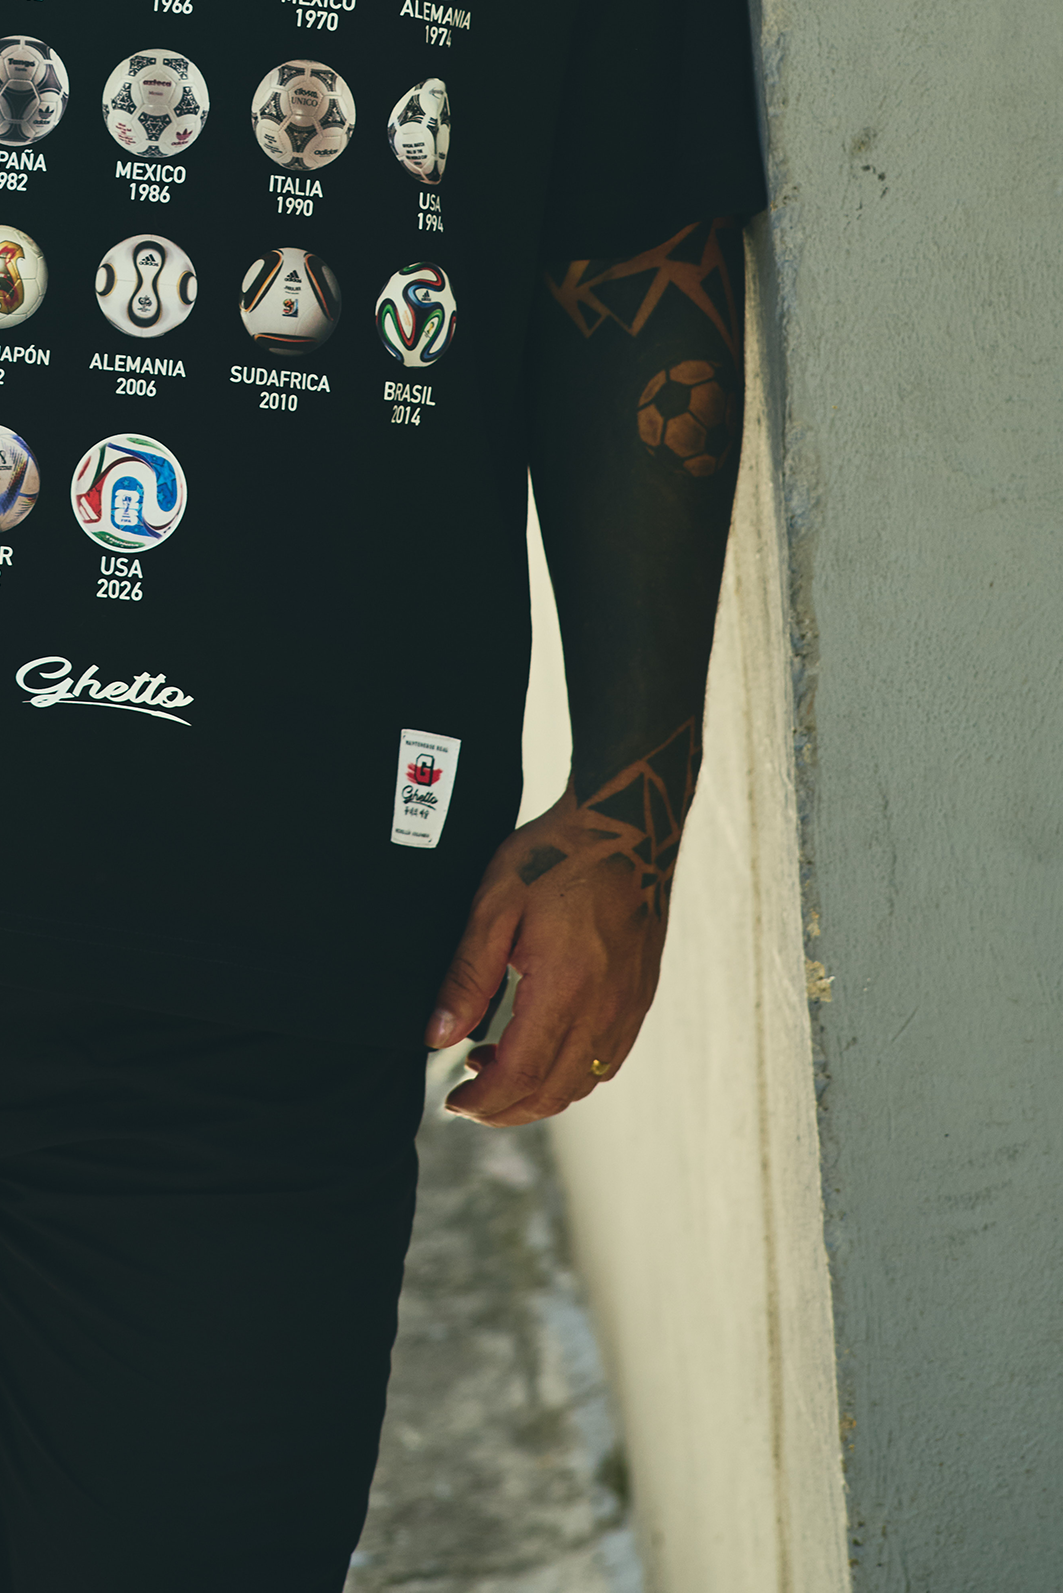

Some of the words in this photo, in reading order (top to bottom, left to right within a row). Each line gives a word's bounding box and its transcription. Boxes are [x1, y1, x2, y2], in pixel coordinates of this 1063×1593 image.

[295, 8, 339, 32] 1970
[425, 24, 452, 48] 1974
[291, 96, 318, 108] UNICO
[115, 160, 187, 184] MEXICO
[129, 182, 171, 204] 1986
[268, 174, 324, 198] ITALIA
[276, 195, 314, 217] 1990
[418, 191, 442, 213] USA
[417, 212, 444, 233] 1994
[88, 352, 187, 378] ALEMANIA
[115, 377, 157, 397] 2006
[229, 365, 331, 393] SUDAFRICA
[259, 391, 298, 412] 2010
[383, 381, 436, 407] BRASIL
[390, 404, 421, 427] 2014
[100, 555, 144, 579] USA
[96, 578, 143, 602] 2026
[16, 656, 195, 727] Ghetto
[401, 785, 439, 811] Ghetto
